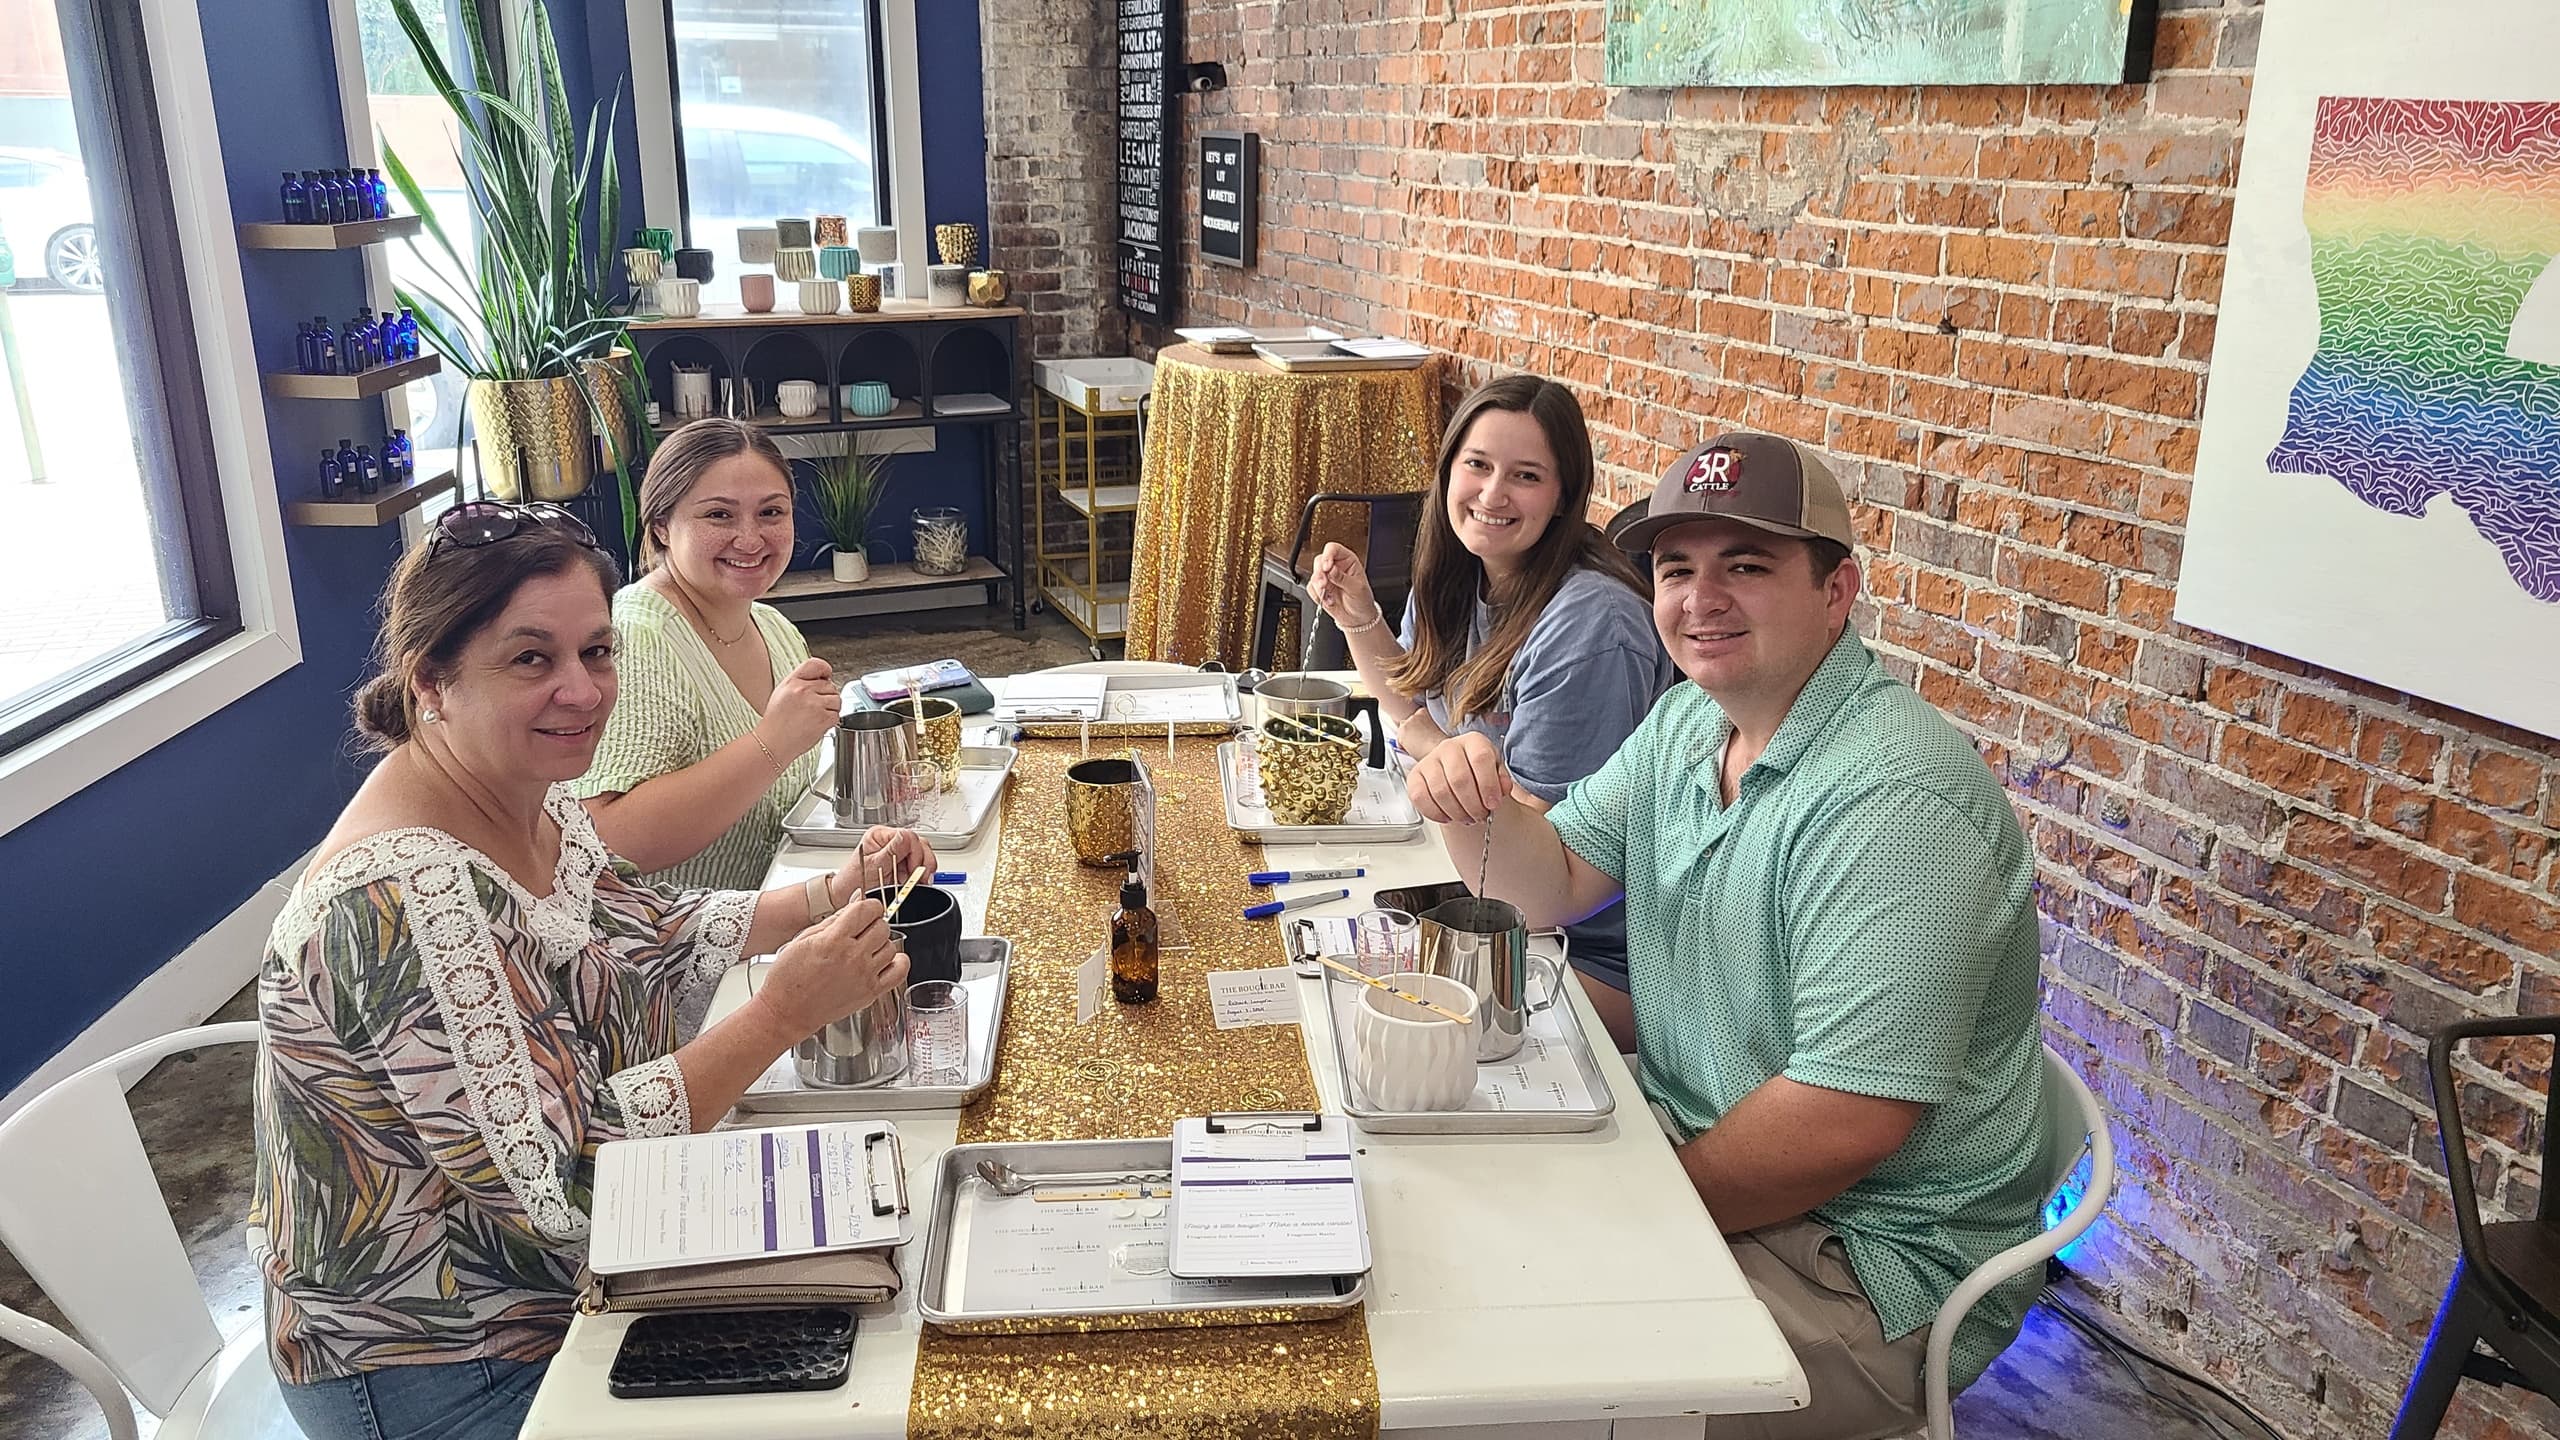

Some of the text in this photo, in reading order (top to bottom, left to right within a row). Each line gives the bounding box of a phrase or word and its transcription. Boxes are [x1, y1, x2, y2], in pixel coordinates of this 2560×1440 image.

[1124, 30, 1157, 52] POLK ST
[1119, 51, 1162, 70] JOHNSTON ST
[1130, 84, 1144, 102] AVE
[1126, 104, 1153, 118] CONGRESS
[1154, 104, 1162, 119] ST
[1120, 121, 1145, 140] GARFIELD
[1120, 142, 1161, 168] LEE AVE
[1206, 151, 1237, 166] LET'S GET
[1128, 167, 1142, 185] JOHN
[1143, 169, 1149, 185] ST
[1121, 185, 1153, 206] LAFAYETTE
[1120, 204, 1153, 222] WASHINGTON
[1124, 220, 1151, 241] JACKSON
[1120, 256, 1160, 281] LAFAYETTE
[1121, 272, 1159, 296] LOUISIANA
[1692, 453, 1730, 483] 3R
[1689, 482, 1730, 493] CATTLE
[1270, 982, 1286, 990] BAR
